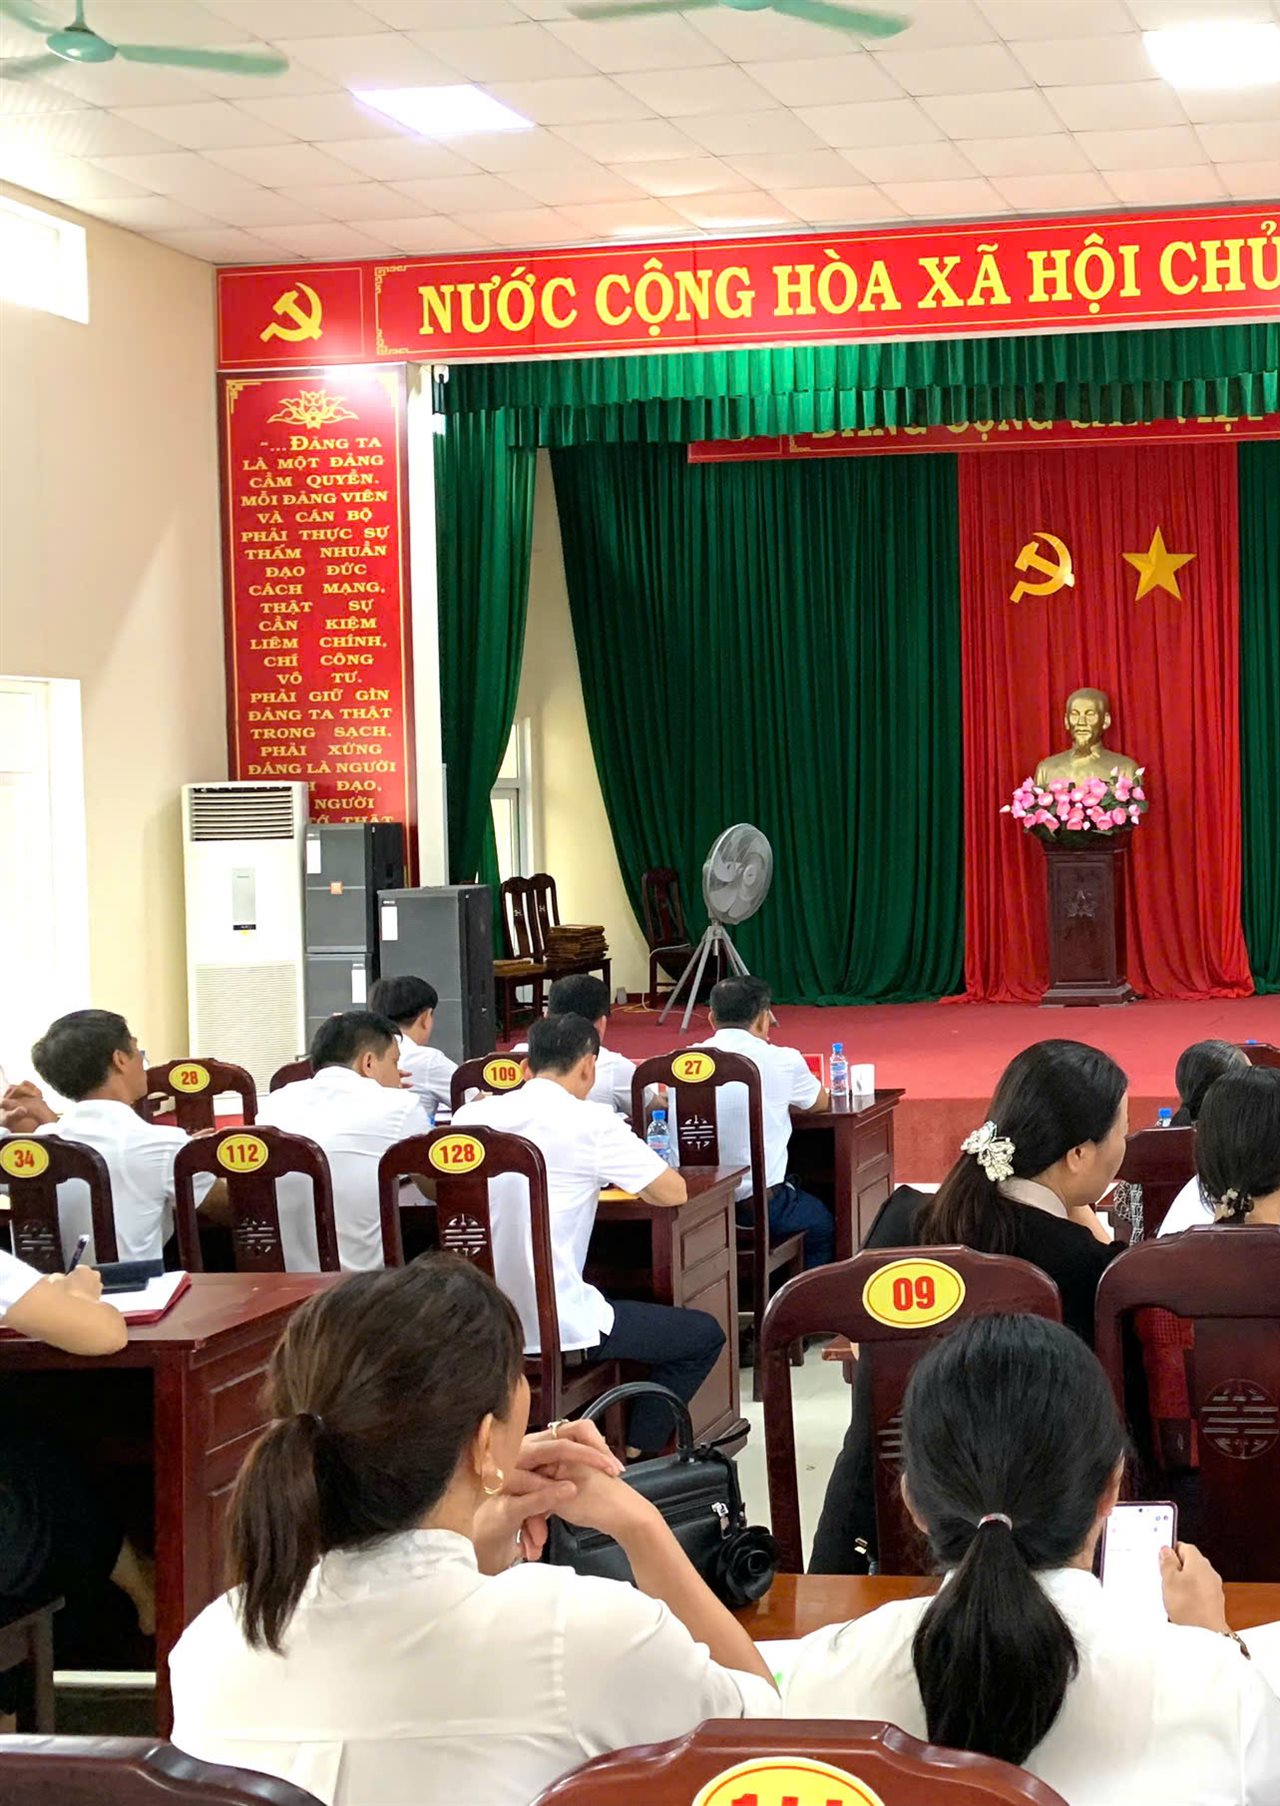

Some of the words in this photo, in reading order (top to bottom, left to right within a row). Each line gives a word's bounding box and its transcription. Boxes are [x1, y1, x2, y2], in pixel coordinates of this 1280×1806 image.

[418, 269, 577, 334] NƯỚC
[595, 257, 756, 336] CỘNG
[772, 249, 901, 316] HÒA
[918, 243, 1011, 309] XÃ
[1027, 232, 1141, 313] HỘI
[355, 437, 382, 448] TA
[243, 457, 268, 470] LÀ
[278, 456, 320, 471] MỘT
[330, 453, 384, 467] ĐẢNG
[250, 472, 293, 488] CẦM
[241, 491, 278, 506] MỖI
[283, 491, 337, 505] ĐẢNG
[341, 489, 388, 502] VIÊN
[257, 511, 284, 524] VÀ
[296, 509, 334, 523] CÁN
[347, 508, 372, 523] BỘ
[241, 528, 288, 542] PHẢI
[299, 527, 353, 542] THỰC
[364, 525, 389, 540] SỰ
[244, 544, 301, 559] THẤM
[320, 541, 387, 558] NHUẦN
[265, 566, 305, 579] ĐẠO
[327, 562, 367, 576] ĐỨC
[249, 582, 303, 596] CÁCH
[260, 600, 313, 615] THẬT
[348, 599, 374, 613] SỰ
[259, 615, 298, 631] CẦN
[325, 616, 377, 632] KIỆM
[250, 636, 299, 650] LIÊM
[264, 653, 298, 667] CHÍ
[320, 652, 374, 666] CÔNG
[276, 671, 302, 685] VÔ
[250, 689, 296, 703] PHẢI
[309, 688, 343, 702] GIỮ
[356, 688, 389, 701] GÌN
[248, 707, 302, 721] ĐẢNG
[308, 709, 334, 720] TA
[340, 706, 392, 720] THẬT
[251, 727, 316, 740] TRONG
[260, 743, 307, 757] PHẢI
[328, 743, 383, 756] XỨNG
[248, 761, 302, 775] ĐÁNG
[307, 759, 331, 774] LÀ
[337, 759, 396, 772] NGƯỜI
[315, 797, 375, 809] NGƯỜI
[490, 1065, 516, 1081] 109
[684, 1060, 702, 1075] 27
[181, 1070, 198, 1086] 28
[14, 1149, 35, 1168] 34
[227, 1144, 258, 1163] 112
[439, 1144, 475, 1163] 128
[892, 1276, 935, 1312] 09
